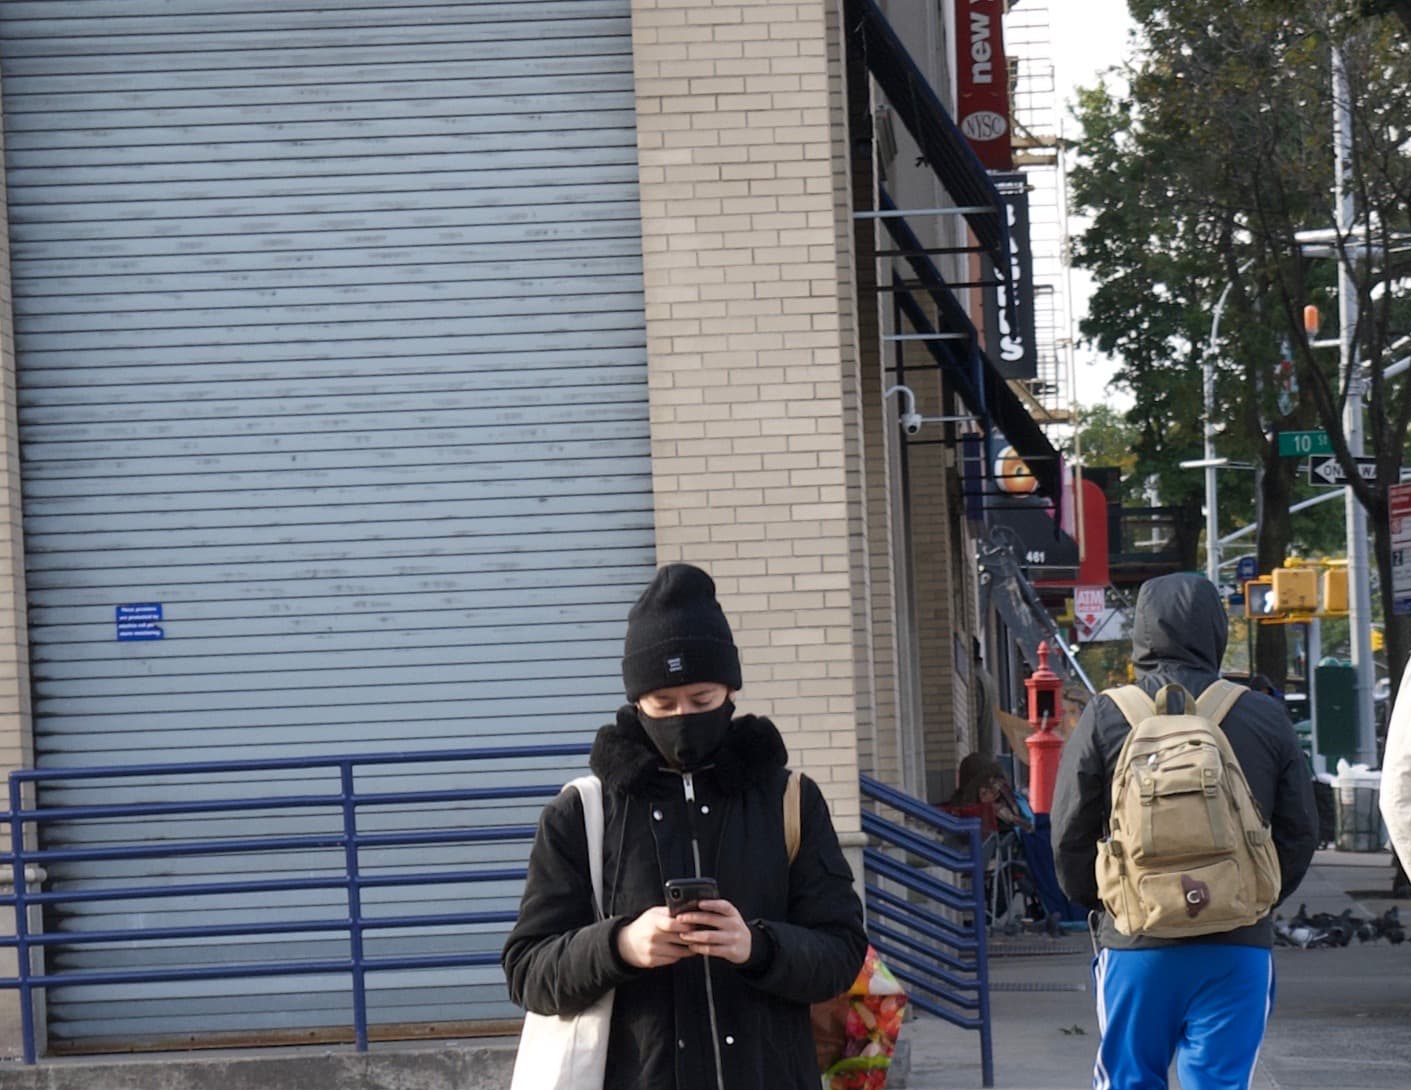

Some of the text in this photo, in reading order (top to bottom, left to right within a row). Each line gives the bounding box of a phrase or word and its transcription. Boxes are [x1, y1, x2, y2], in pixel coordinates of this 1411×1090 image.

[970, 12, 992, 84] new
[965, 114, 1001, 139] NYSC
[1294, 435, 1311, 452] 10
[1323, 464, 1344, 477] ON
